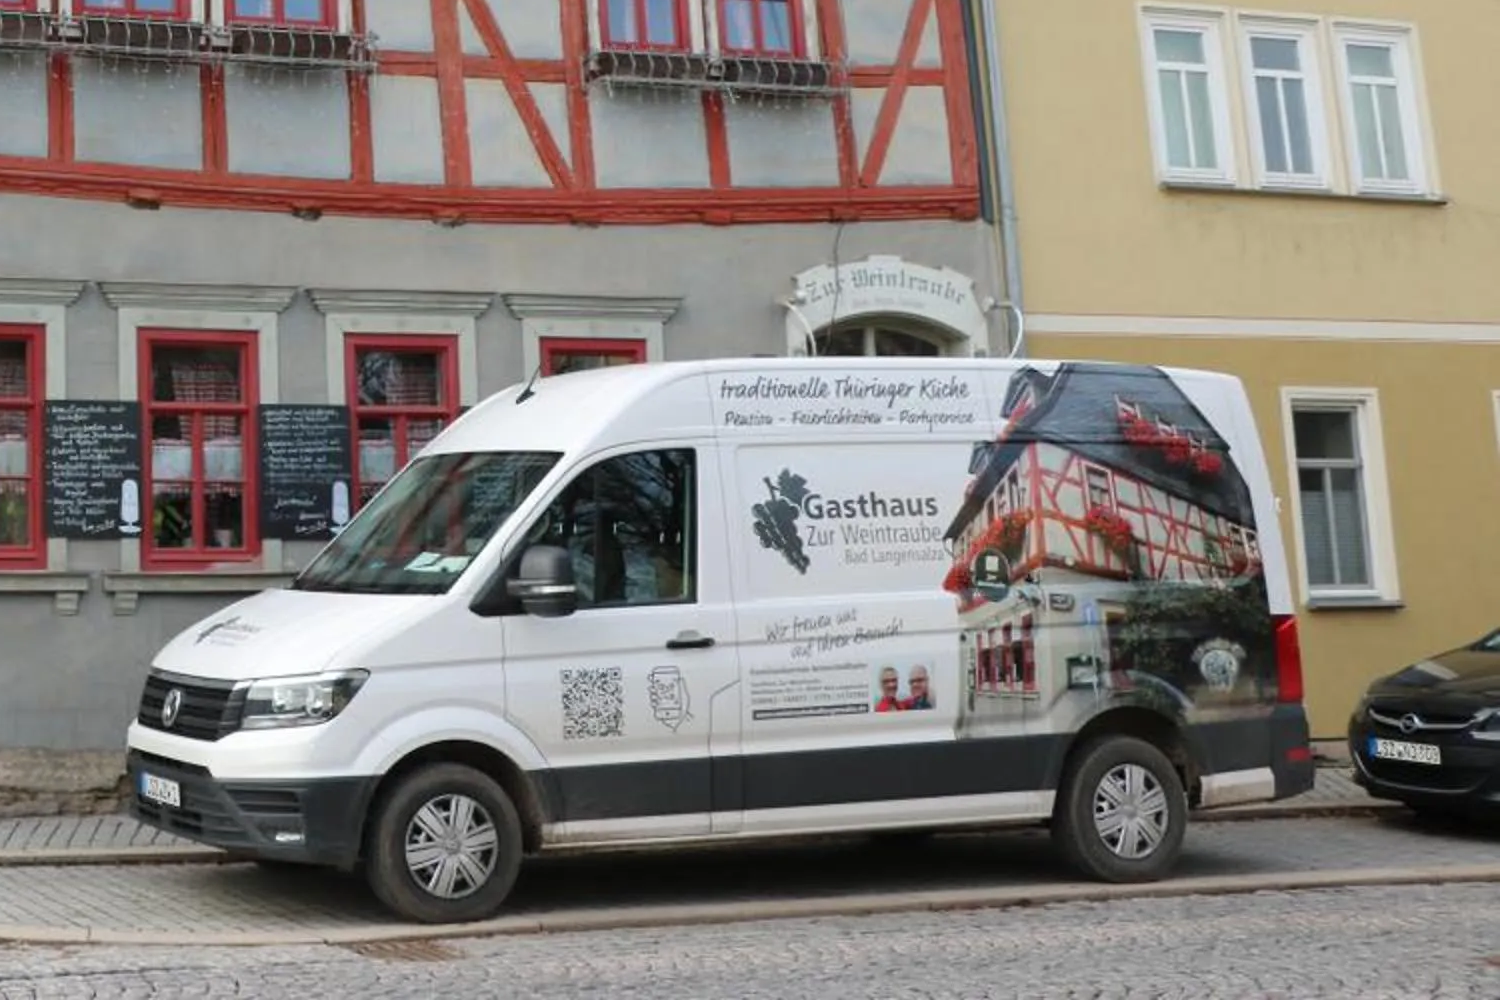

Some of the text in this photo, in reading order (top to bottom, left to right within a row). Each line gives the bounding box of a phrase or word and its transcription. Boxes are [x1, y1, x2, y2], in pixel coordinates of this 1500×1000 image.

[805, 278, 844, 302] Zur
[851, 268, 966, 305] Weintraube
[720, 375, 970, 408] traditionelle Thüringer Küche
[725, 410, 773, 426] Pension
[803, 491, 939, 520] Gasthaus
[805, 520, 942, 548] Zur Weintraube
[845, 548, 945, 567] Bad Langensalza
